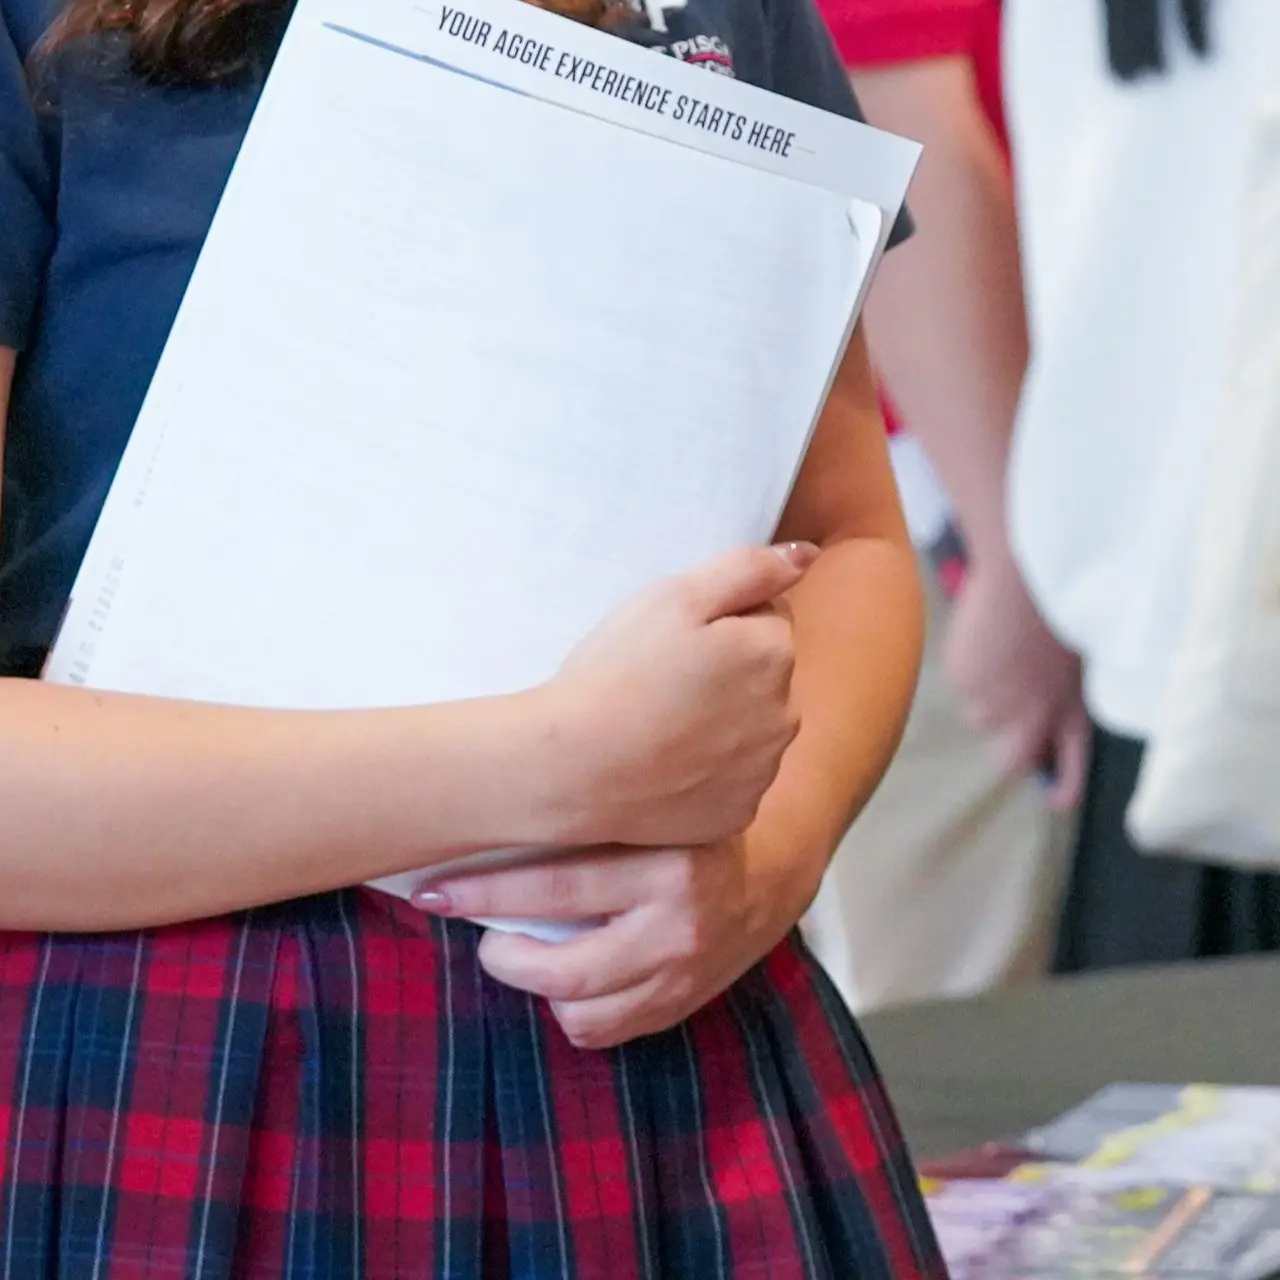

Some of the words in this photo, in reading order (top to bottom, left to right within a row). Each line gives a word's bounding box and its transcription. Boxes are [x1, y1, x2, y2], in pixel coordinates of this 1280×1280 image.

[437, 5, 492, 47] YOUR
[494, 29, 555, 71] AGGIE
[555, 52, 674, 114] EXPERIENCE
[673, 95, 747, 141] STARTS
[747, 121, 796, 157] HERE
